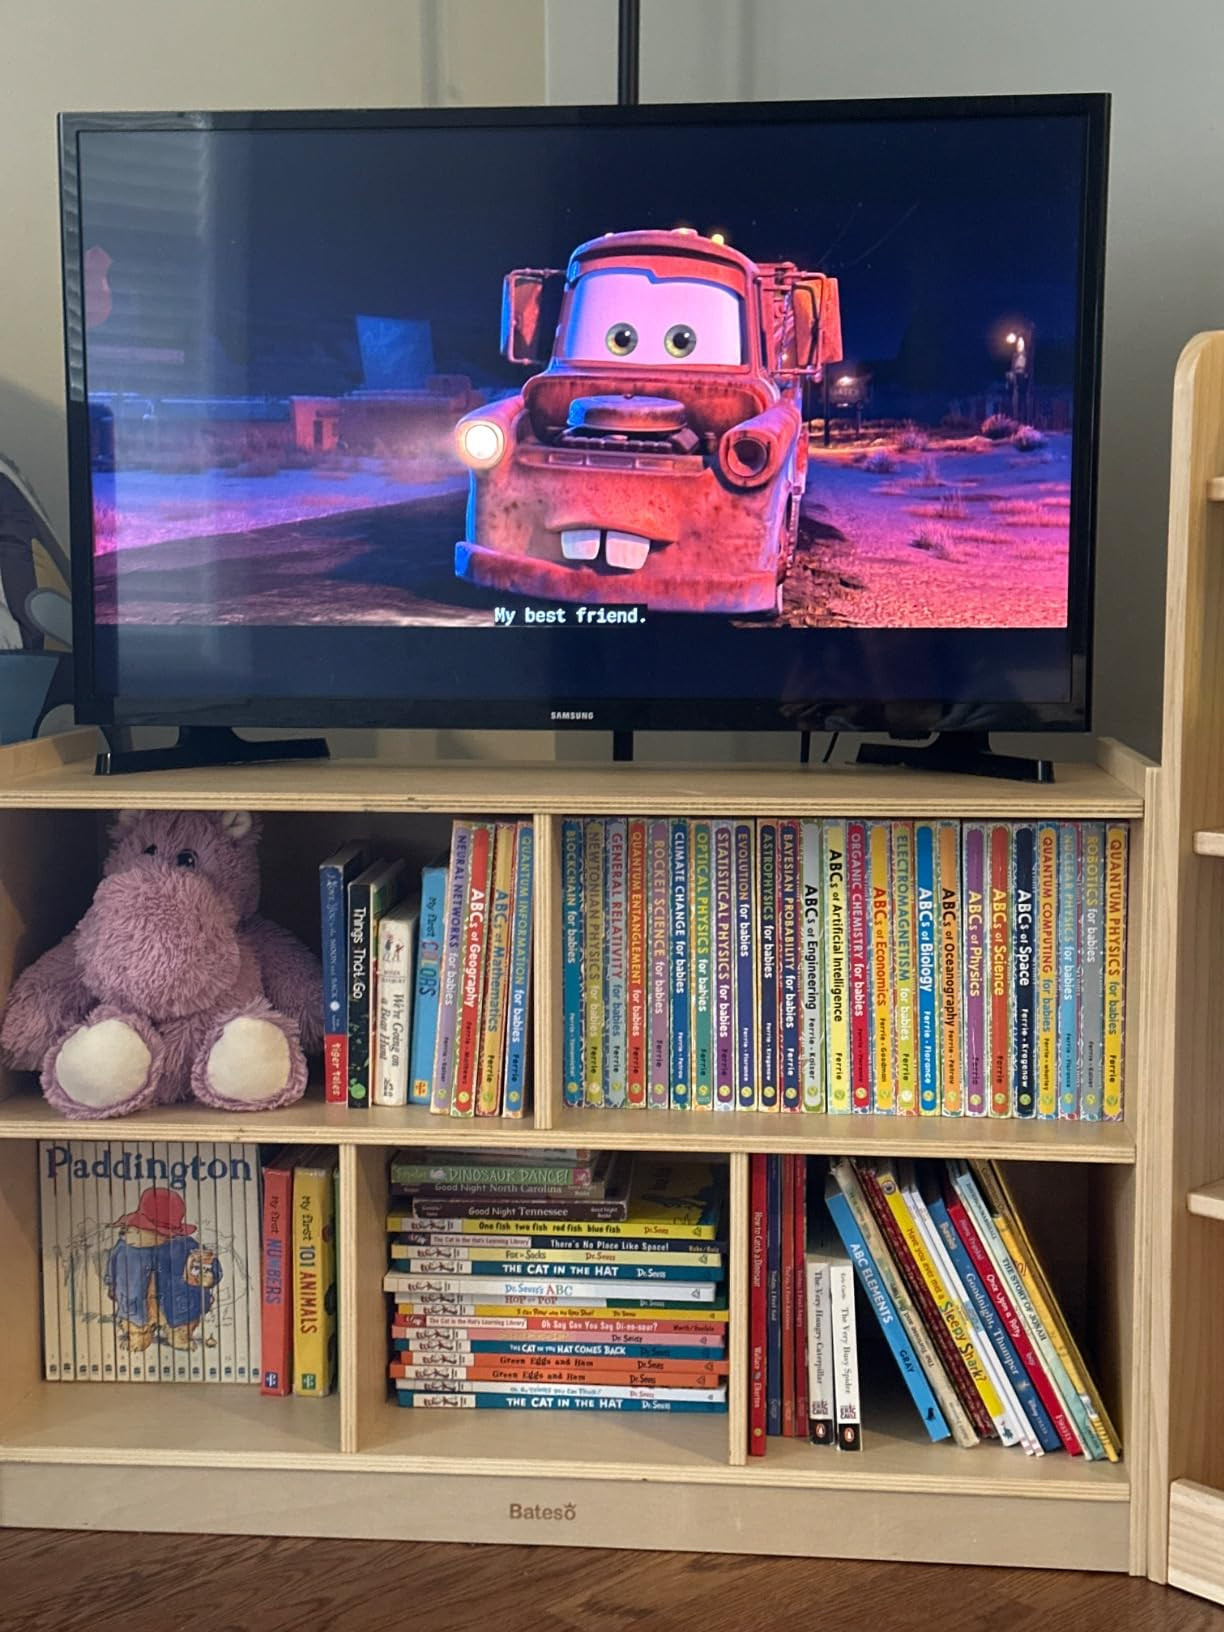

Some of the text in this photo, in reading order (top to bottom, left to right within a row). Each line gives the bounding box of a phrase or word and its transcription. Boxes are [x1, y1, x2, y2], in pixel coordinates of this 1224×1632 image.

[494, 607, 646, 625] My best friend.
[551, 712, 594, 720] SAMSUNG
[445, 835, 466, 1005] NEURAL NETWORKS for babies
[493, 889, 507, 928] ABCs
[675, 832, 686, 993] CLIMATE CHANGE for babies
[697, 832, 708, 1011] OPTICAL PHYSICS for babies
[738, 833, 750, 957] EVOLUTION for babies
[351, 908, 366, 999] Things That Go
[464, 888, 484, 1008] ABCs of Geography
[512, 836, 531, 1042] QUANTUM INFORMATION for babies
[784, 834, 796, 1028] BAYESIAN PROBABILITY for babies
[805, 885, 819, 1009] ABCs of Engineering
[829, 849, 844, 1022] ABCs of Artificial Intelligence
[919, 888, 933, 991] ABCs of Biology
[942, 888, 957, 1026] ABCs of Oceanography
[969, 891, 982, 996] ABCs of Physics
[993, 888, 1006, 995] ABCs of Science
[1017, 889, 1031, 986] ABCs of Space
[1108, 840, 1121, 1034] QUANTUM PHYSICS for babies
[489, 946, 505, 1032] Mathematics
[331, 1043, 341, 1068] tiger
[512, 1054, 520, 1082] Ferrie
[787, 1048, 795, 1076] Ferrie
[835, 1052, 843, 1080] Ferrie
[924, 1045, 932, 1083] Florance
[1021, 1009, 1029, 1088] Ferrie Kregenow
[1109, 1055, 1117, 1082] Ferrie
[332, 1071, 342, 1095] tales
[46, 1147, 252, 1190] Paddington
[435, 1184, 562, 1194] Good Night North Carolina
[449, 1169, 515, 1181] DINOSAUR
[300, 1195, 310, 1210] My
[492, 1208, 515, 1216] Night
[519, 1207, 568, 1217] Tennessee
[567, 1224, 582, 1232] fish
[606, 1225, 620, 1233] fish
[754, 1212, 762, 1225] How
[265, 1238, 281, 1304] NUMBERS
[300, 1246, 315, 1267] 101
[502, 1265, 619, 1276] THE CAT IN THE HAT
[551, 1240, 579, 1248] There's
[597, 1242, 619, 1250] Place
[622, 1242, 639, 1250] Like
[642, 1242, 669, 1251] Space!
[754, 1235, 762, 1252] Catch
[754, 1260, 762, 1287] Dinosaur
[300, 1271, 317, 1334] ANIMALS
[812, 1270, 824, 1384] The Very Hungry Caterpillar
[850, 1243, 914, 1373] ABC ELEMENTS GRAY
[907, 1228, 919, 1246] Have
[914, 1248, 925, 1260] you
[923, 1263, 934, 1278] ever
[930, 1280, 942, 1293] met
[940, 1301, 966, 1340] Sleepy
[959, 1343, 987, 1381] Shark?
[967, 1273, 996, 1328] Goodnight,
[994, 1328, 1020, 1375] Thumper
[1002, 1257, 1046, 1340] THE STORY OF JONAH
[522, 1371, 543, 1379] Eggs
[840, 1307, 852, 1393] The Very Busy Spider
[531, 1399, 554, 1407] CAT
[600, 1400, 623, 1408] HAT
